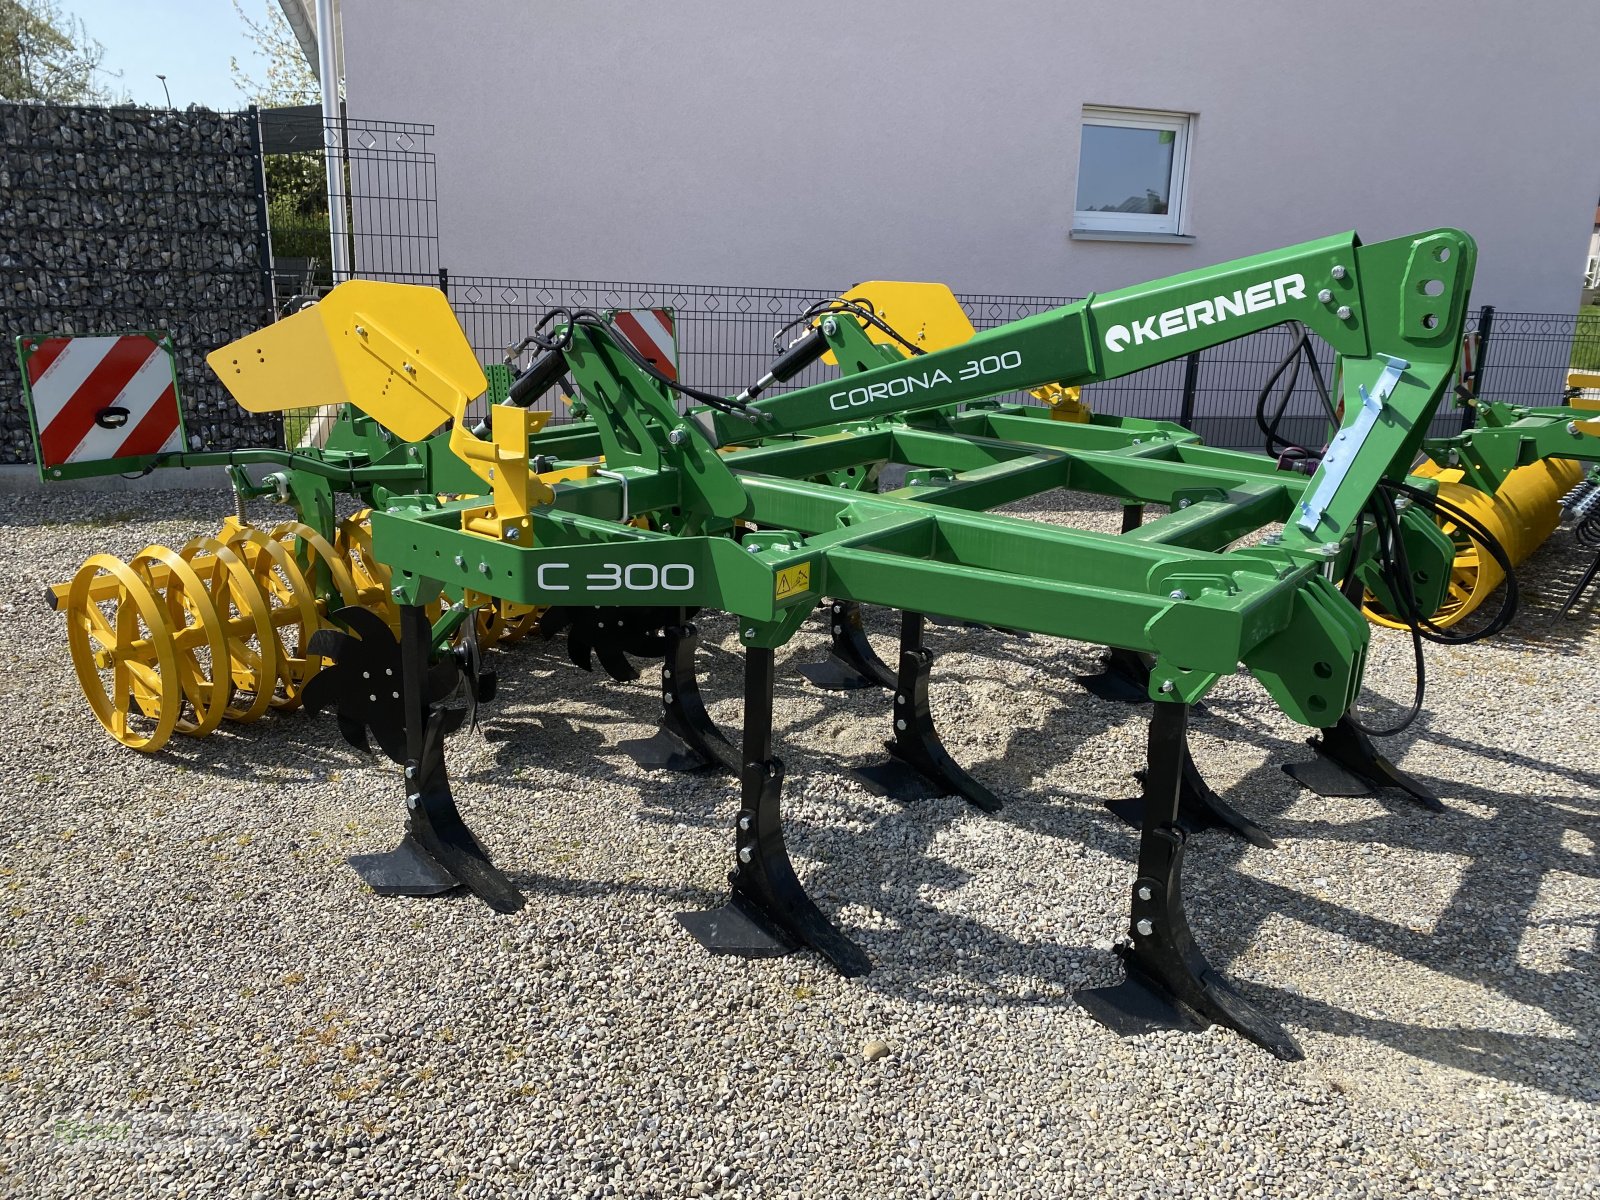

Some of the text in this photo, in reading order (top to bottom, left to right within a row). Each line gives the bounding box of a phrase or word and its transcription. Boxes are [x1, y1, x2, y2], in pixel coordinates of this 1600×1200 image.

[1131, 273, 1307, 345] KERNER
[829, 350, 1022, 411] CORONA 300
[537, 562, 695, 591] C 300
